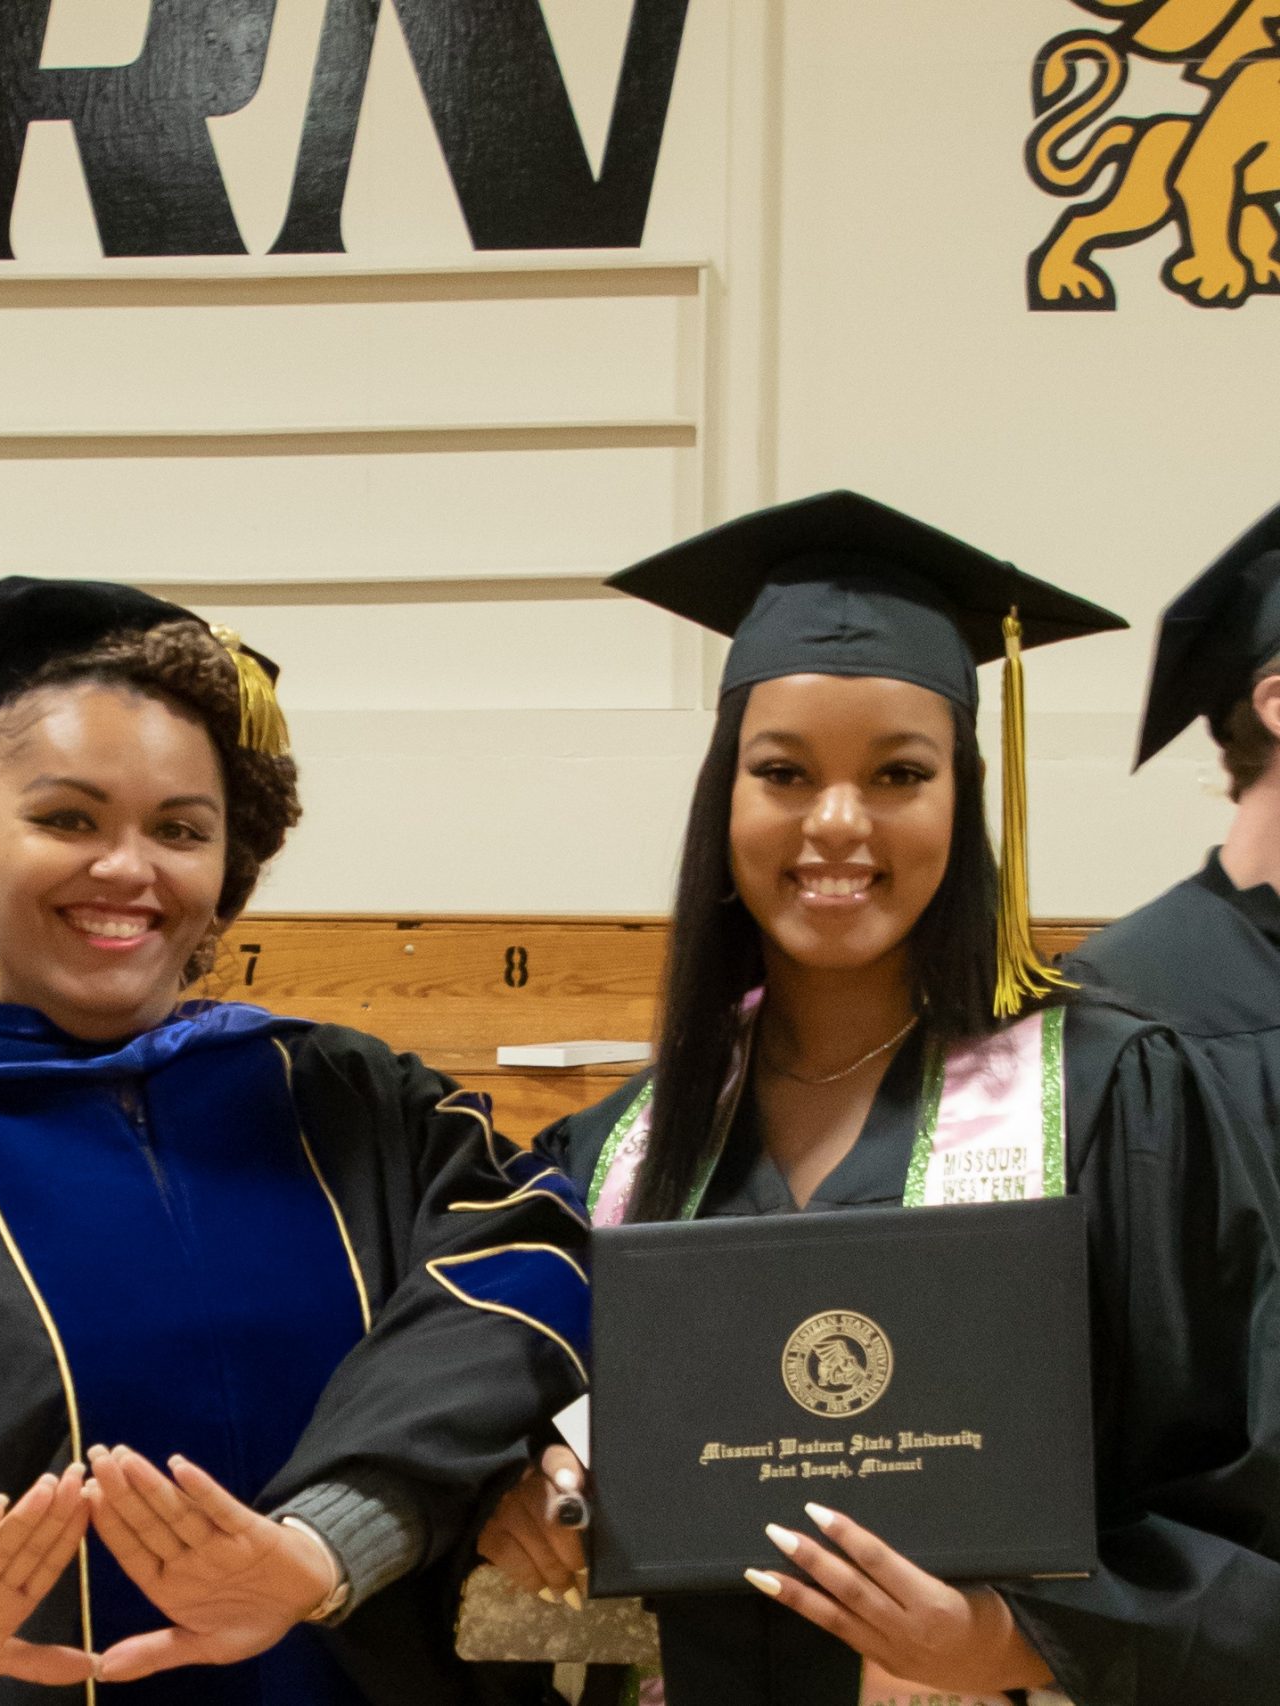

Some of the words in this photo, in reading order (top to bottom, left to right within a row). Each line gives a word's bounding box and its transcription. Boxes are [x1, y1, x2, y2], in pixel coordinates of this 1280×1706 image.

[239, 943, 262, 986] 7
[504, 945, 529, 988] 8
[944, 1147, 1027, 1176] MISSOURI
[943, 1175, 1026, 1204] WESTERN
[699, 1441, 773, 1465] Missouri
[779, 1438, 844, 1459] Western
[849, 1434, 892, 1455] State
[898, 1429, 982, 1453] University
[759, 1463, 797, 1481] Saint
[801, 1460, 853, 1479] Joseph,
[858, 1457, 923, 1478] Missouri
